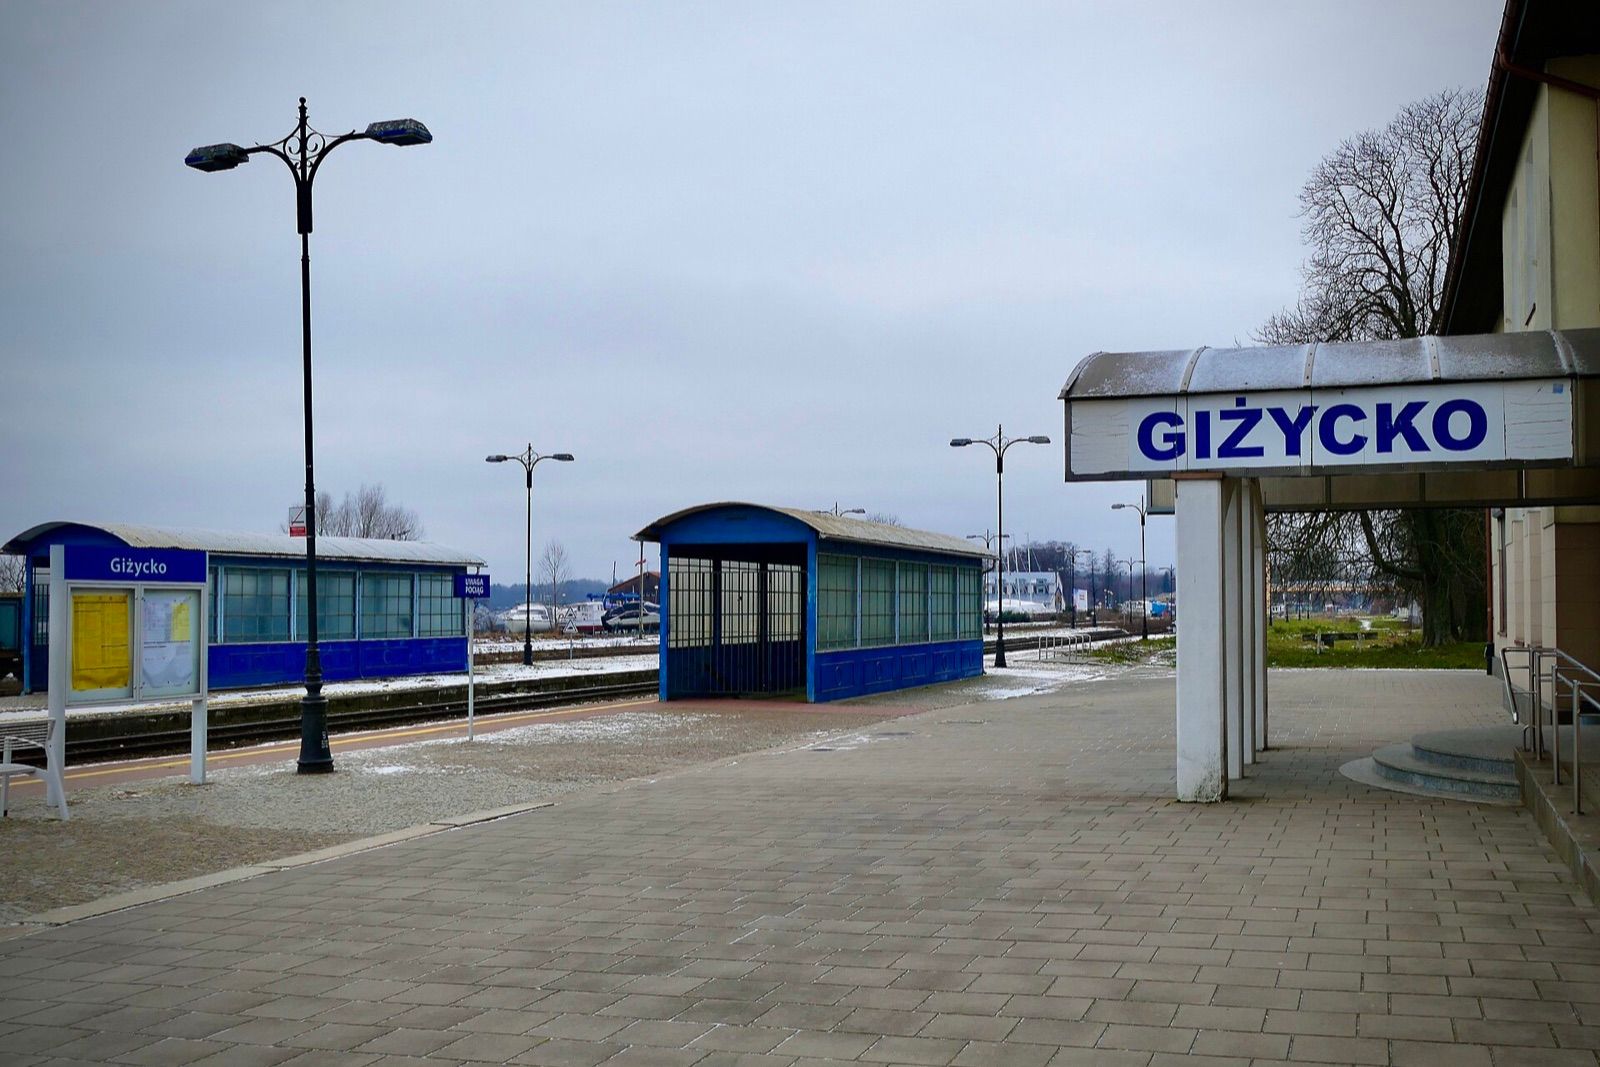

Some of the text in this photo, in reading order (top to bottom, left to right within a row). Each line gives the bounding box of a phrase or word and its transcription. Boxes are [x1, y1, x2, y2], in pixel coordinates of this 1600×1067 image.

[1137, 397, 1488, 461] GIŻYCKO
[110, 557, 167, 577] Giżycko
[465, 578, 484, 586] UWAGA
